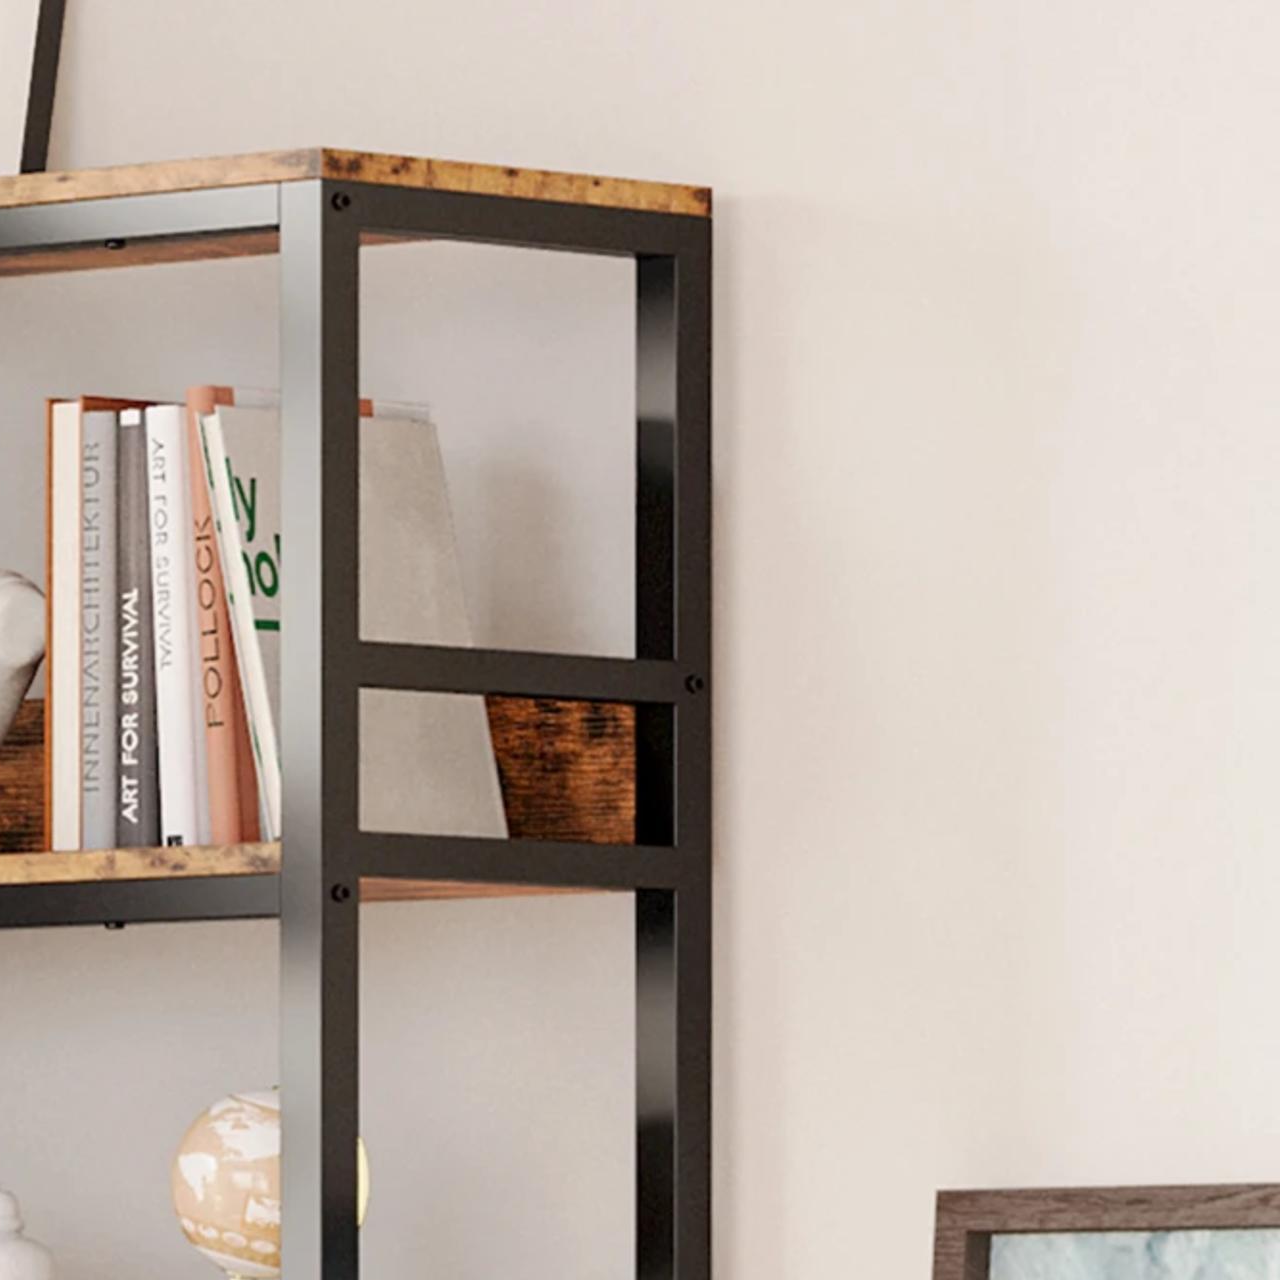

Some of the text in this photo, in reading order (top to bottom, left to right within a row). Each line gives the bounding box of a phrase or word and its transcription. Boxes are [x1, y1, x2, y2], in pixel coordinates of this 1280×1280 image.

[151, 438, 173, 669] ART FOR SURVIVAL
[195, 515, 224, 728] POLLOCK
[122, 588, 138, 823] ART FOR SURVIVAL
